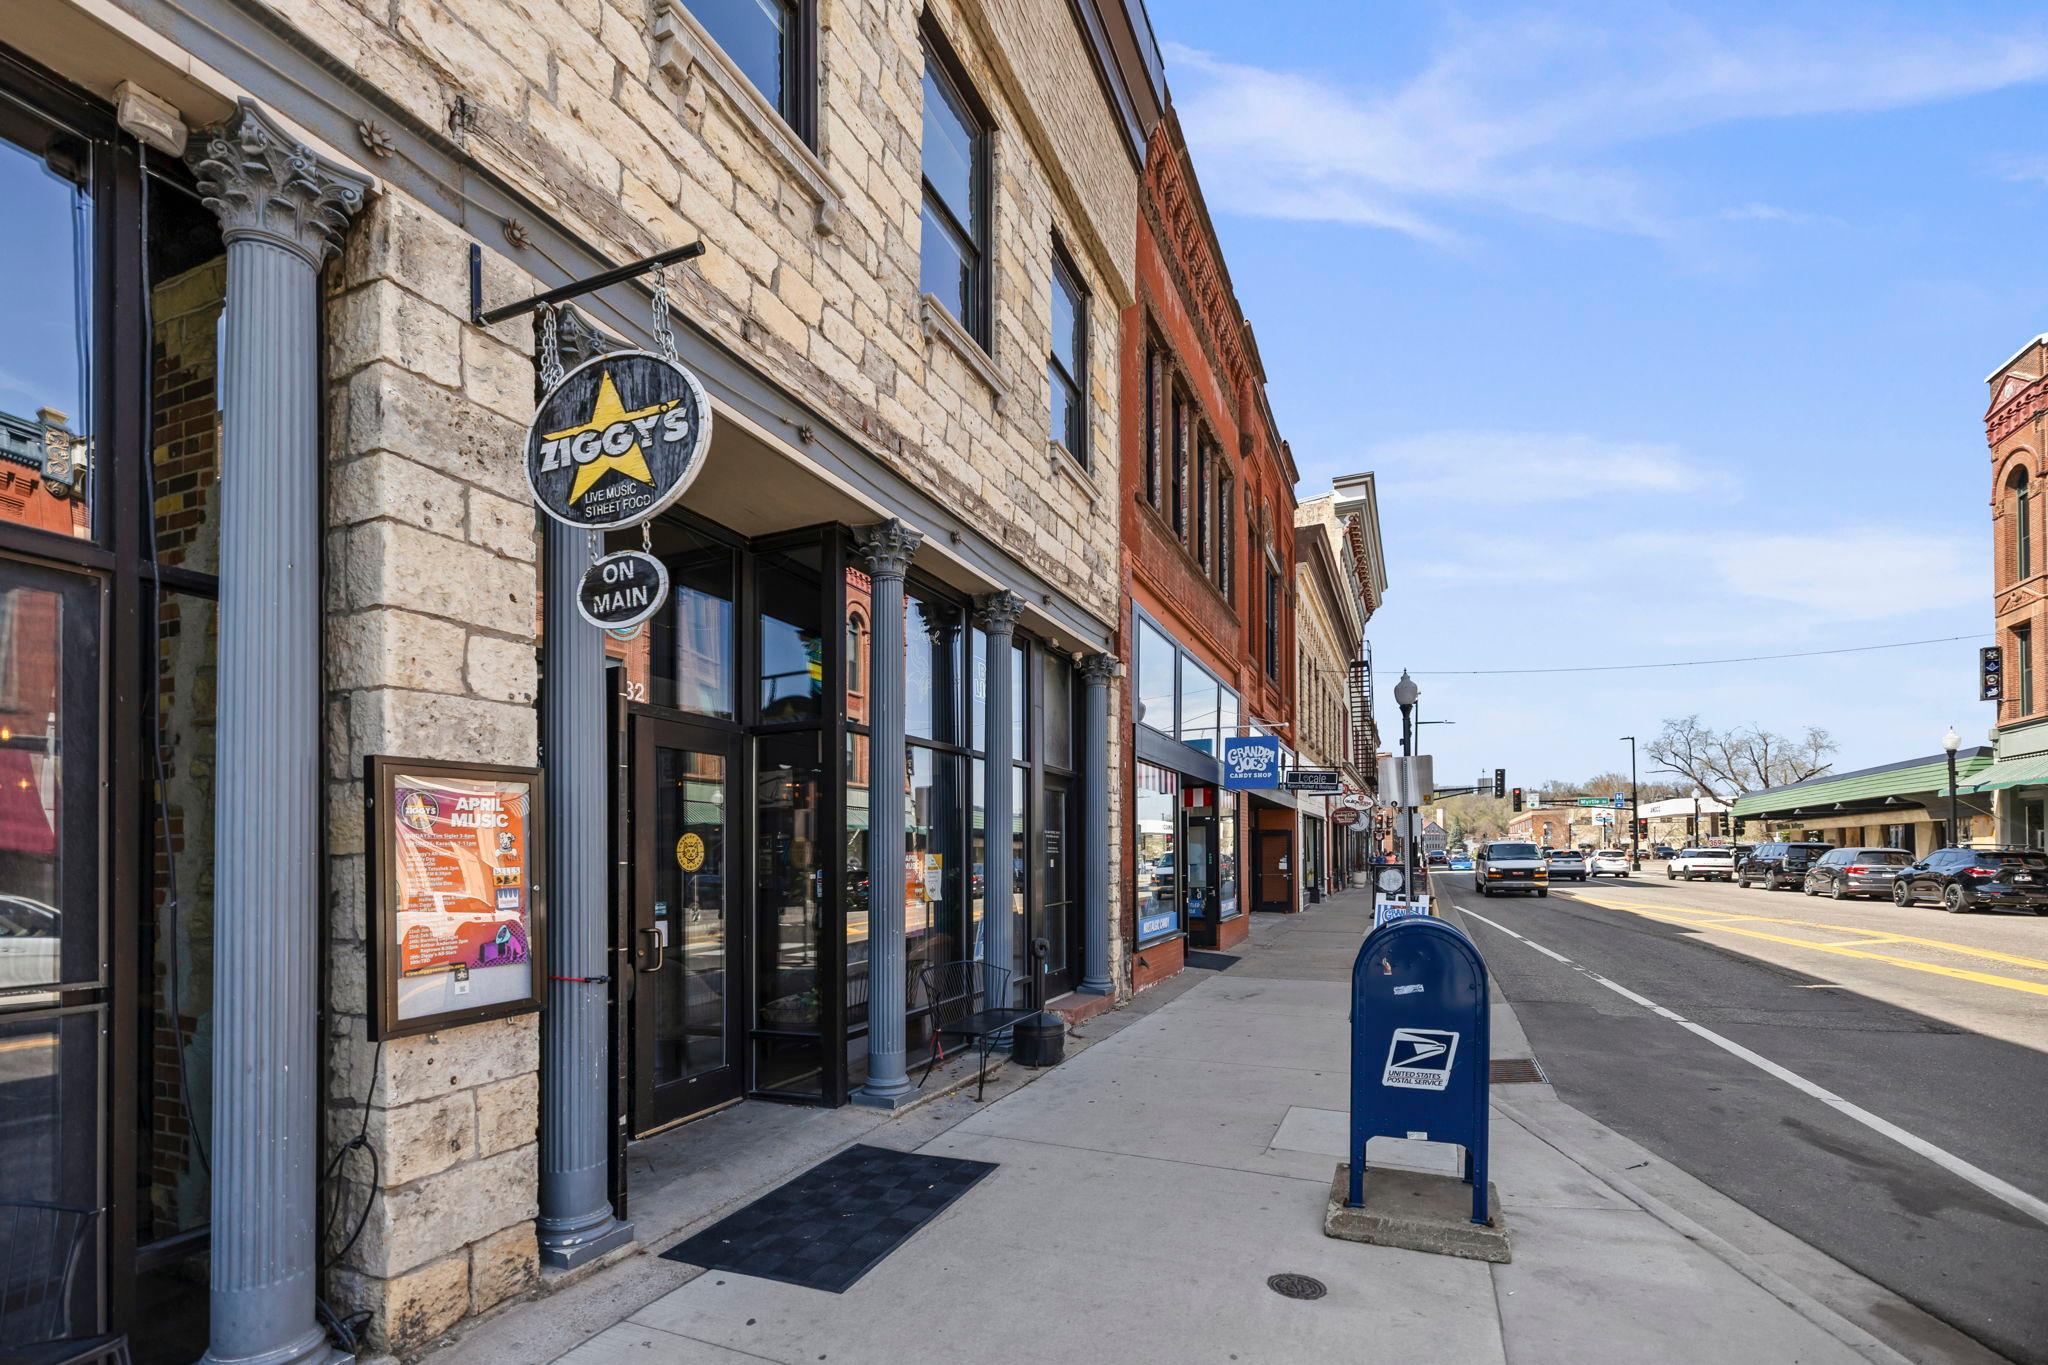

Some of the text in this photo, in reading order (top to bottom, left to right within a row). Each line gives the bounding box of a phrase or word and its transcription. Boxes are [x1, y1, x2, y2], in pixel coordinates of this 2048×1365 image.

[585, 482, 637, 504] LIVE MUSIC
[585, 494, 651, 518] STREET FOOD
[602, 559, 634, 584] ON
[593, 585, 648, 614] MAIN
[1227, 745, 1276, 766] GRANDPA
[455, 797, 505, 812] APRIL
[451, 812, 509, 828] MUSIC
[1386, 1076, 1443, 1087] POSTAL SERVICE
[1388, 1070, 1442, 1080] UNITED STATES
